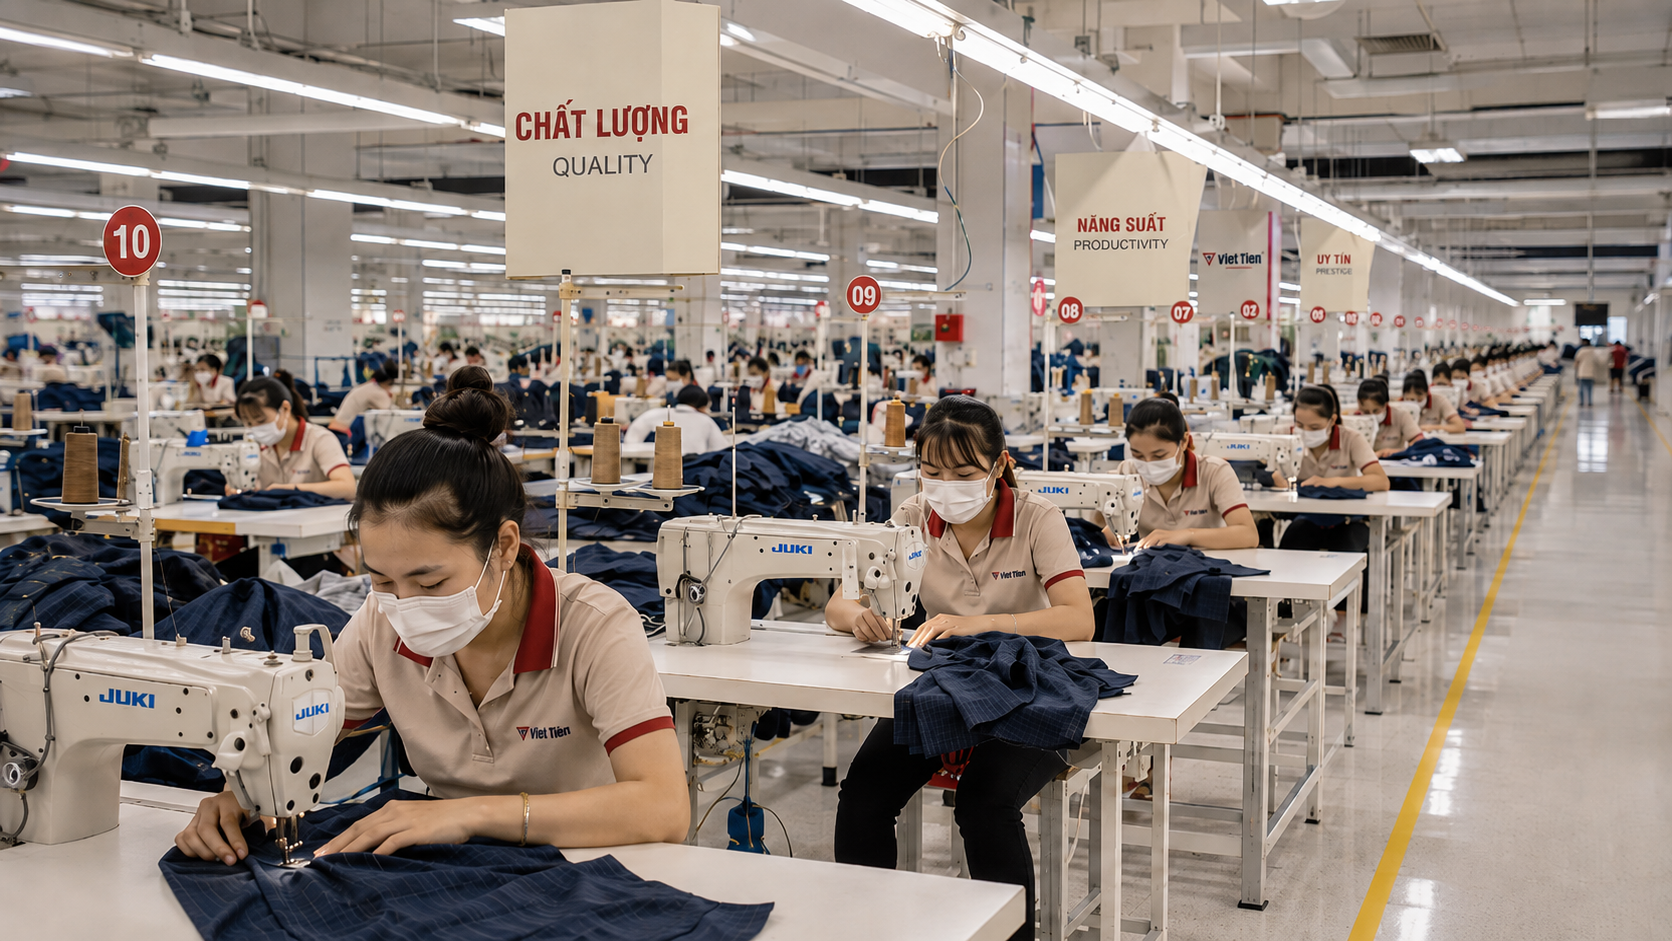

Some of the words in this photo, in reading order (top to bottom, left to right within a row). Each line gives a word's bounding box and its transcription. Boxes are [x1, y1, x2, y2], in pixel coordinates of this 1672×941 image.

[515, 98, 587, 141] CHẤT
[596, 104, 689, 142] LƯỢNG
[552, 153, 653, 178] QUALITY
[1077, 214, 1121, 233] NĂNG
[1125, 211, 1167, 233] SUẤT
[112, 223, 151, 259] 10
[1073, 238, 1169, 251] PRODUCTIVITY
[1217, 252, 1239, 265] Viet
[1317, 253, 1331, 265] UY
[1333, 251, 1351, 265] TÍN
[851, 285, 876, 307] 09
[1060, 303, 1080, 320] 08
[1173, 305, 1192, 321] 07
[1242, 303, 1258, 318] 02
[1037, 486, 1069, 494] JUKI
[771, 543, 813, 555] JUKI
[99, 688, 155, 709] JUKI
[295, 702, 330, 721] JUKI
[530, 726, 548, 740] Viet
